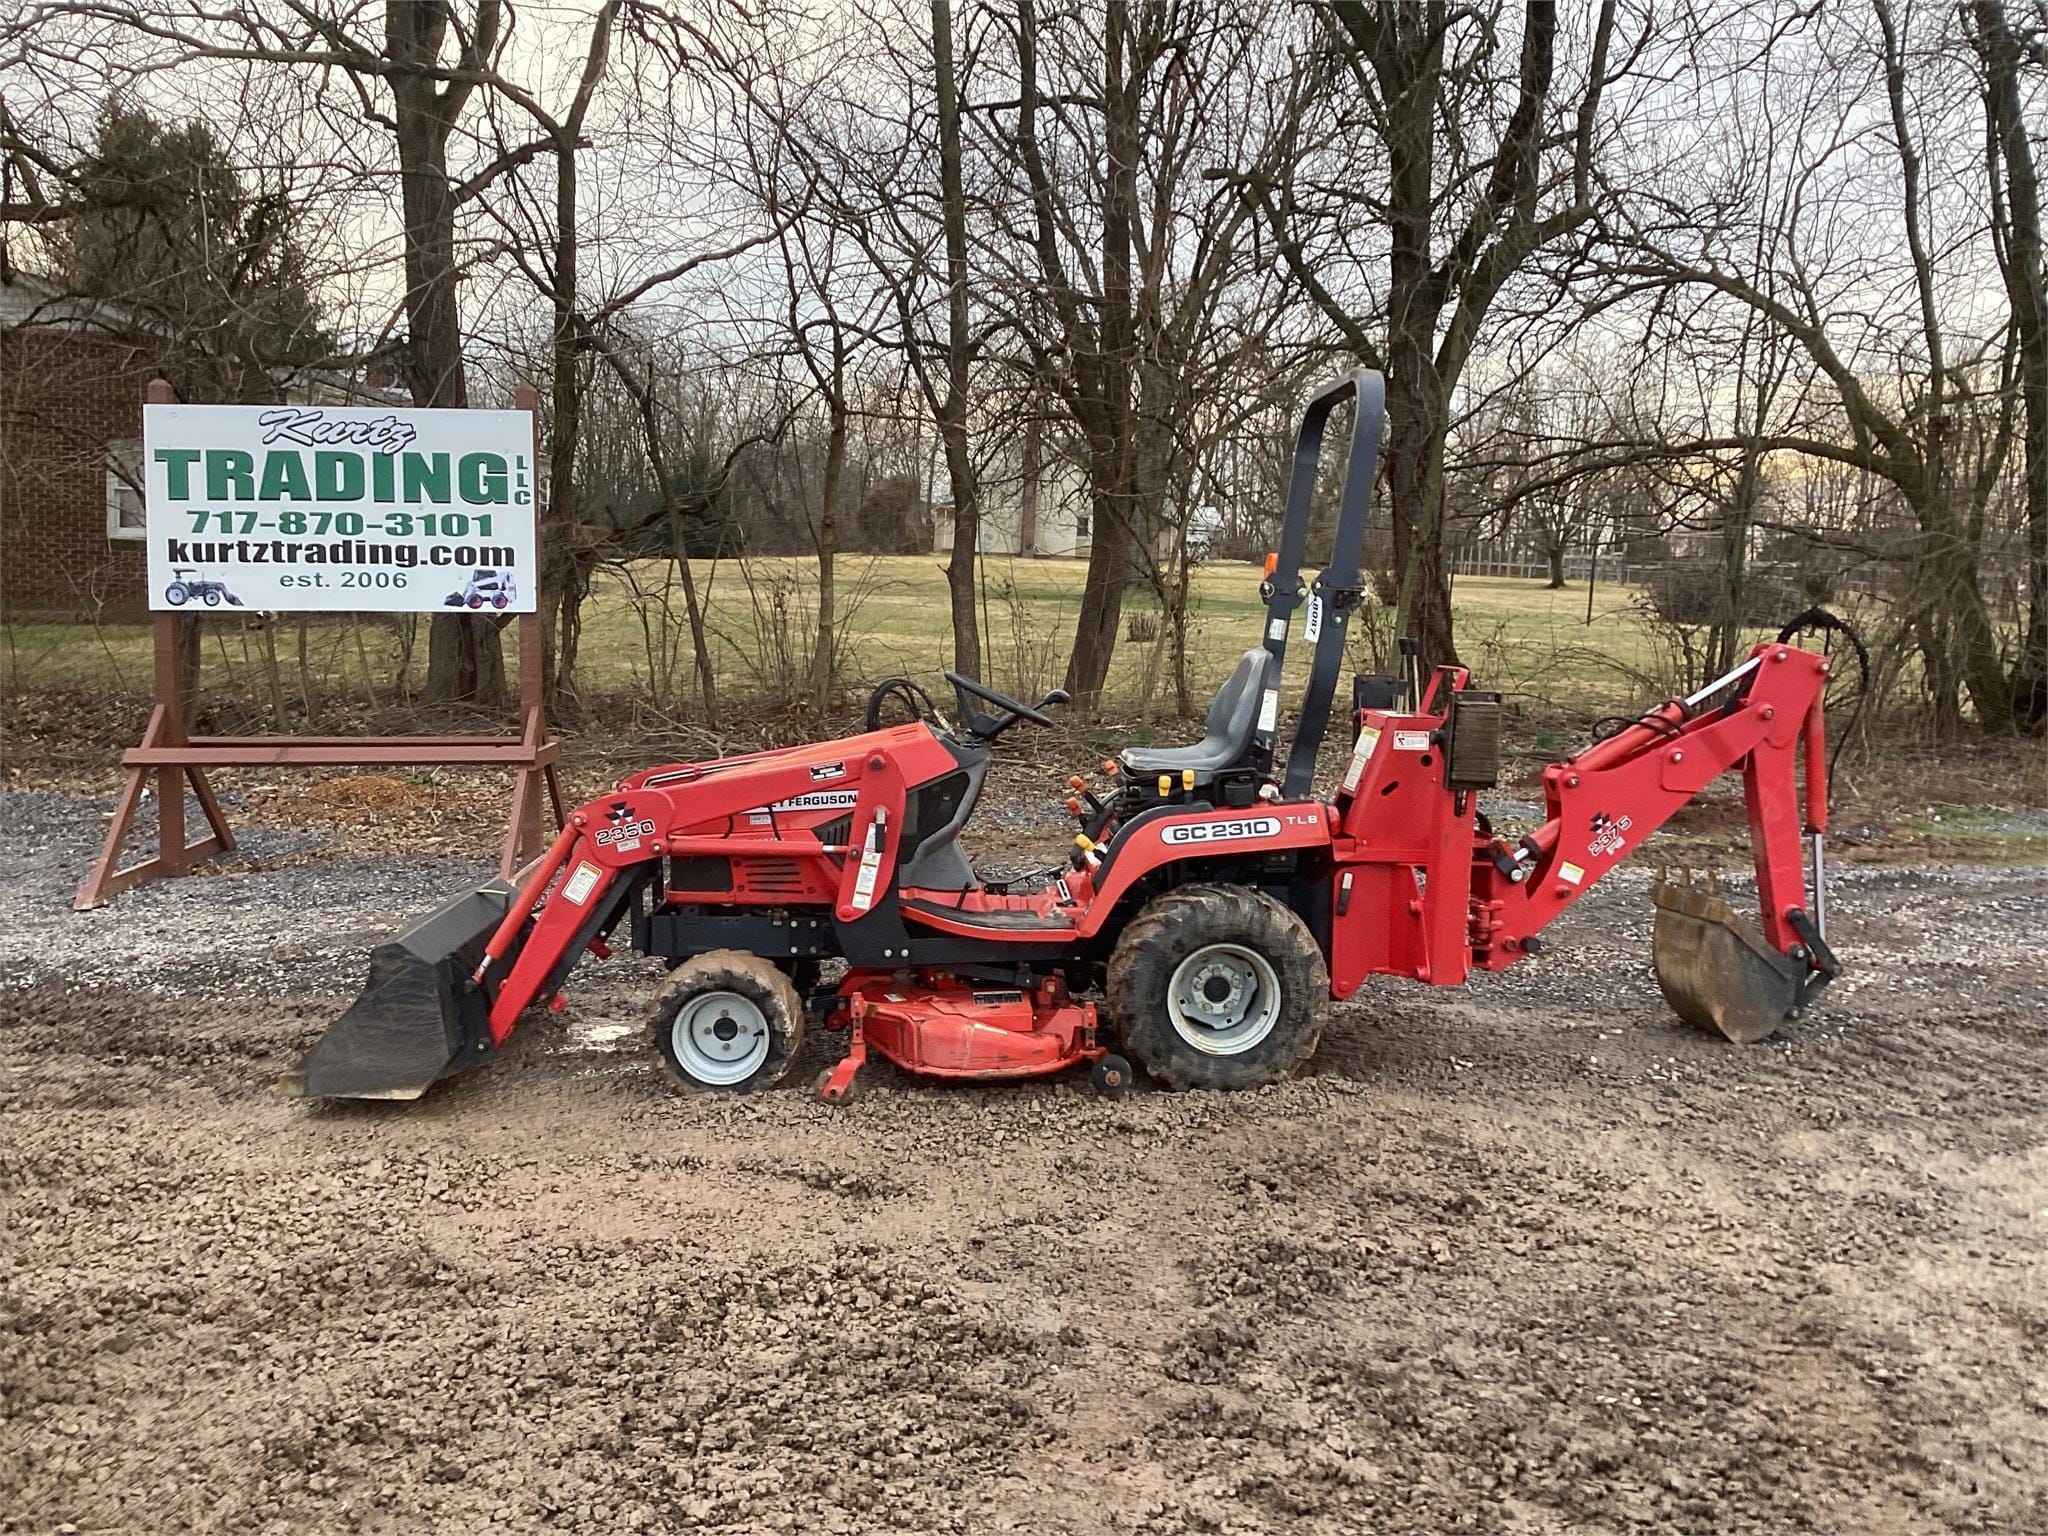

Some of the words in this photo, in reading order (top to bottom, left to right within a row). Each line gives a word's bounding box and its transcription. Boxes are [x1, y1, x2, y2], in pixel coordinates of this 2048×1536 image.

[259, 409, 417, 455] Kurtz
[153, 448, 509, 505] TRADING
[514, 454, 531, 506] LLC
[186, 510, 493, 537] 717-870-3101
[167, 538, 515, 569] kurtztrading.com
[279, 572, 330, 588] est.
[341, 571, 408, 589] 2006
[1310, 602, 1319, 636] 8087
[788, 795, 857, 807] FERGUSON
[595, 819, 655, 846] 2350
[1173, 826, 1207, 841] GC
[1212, 821, 1270, 838] 2310
[1286, 815, 1318, 825] TLB
[1588, 815, 1632, 856] 2375
